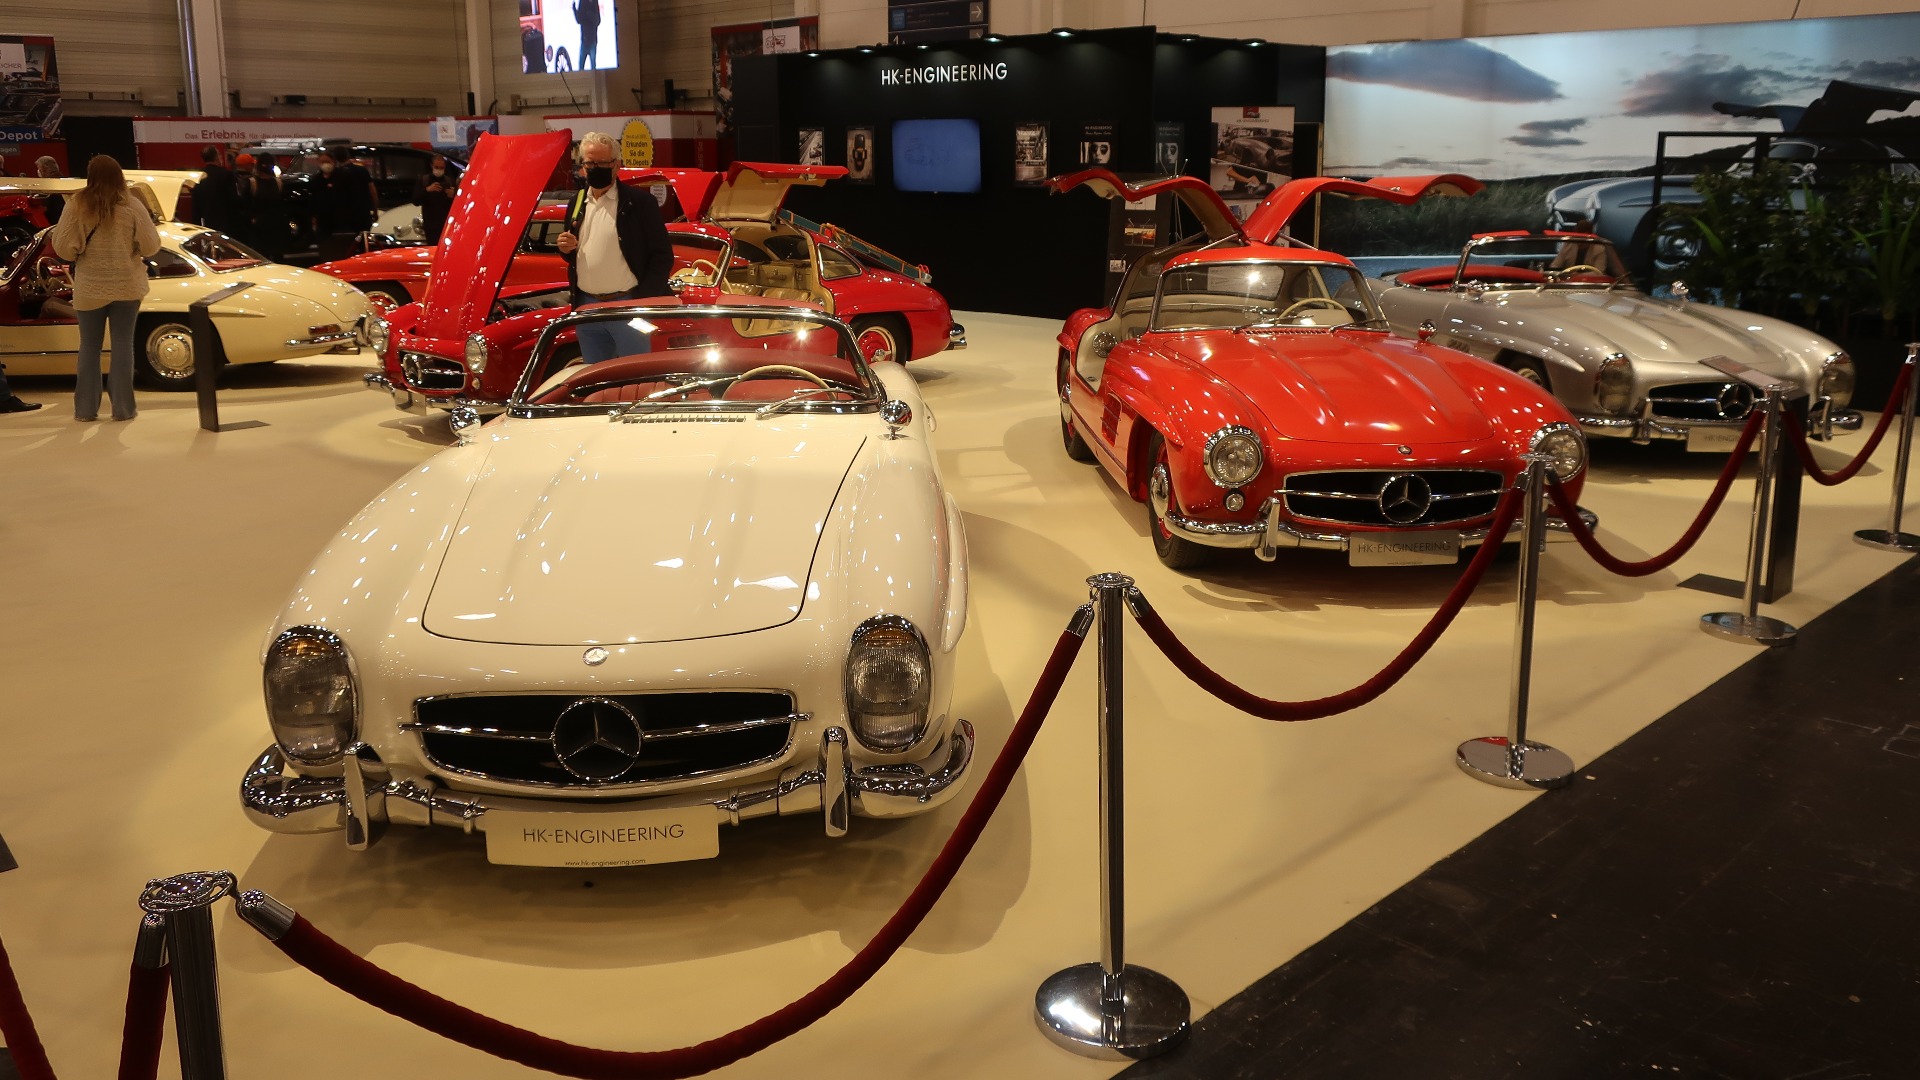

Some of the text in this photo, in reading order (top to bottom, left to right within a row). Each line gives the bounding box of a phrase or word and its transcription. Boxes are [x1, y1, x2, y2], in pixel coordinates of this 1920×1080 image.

[881, 62, 1007, 85] HK-ENGINEERING
[201, 130, 246, 139] Erlebnis
[1358, 542, 1451, 553] HK-ENGINEERING
[523, 824, 684, 844] HK-ENGINEERING
[565, 858, 646, 867] www.hk-engineering.com
